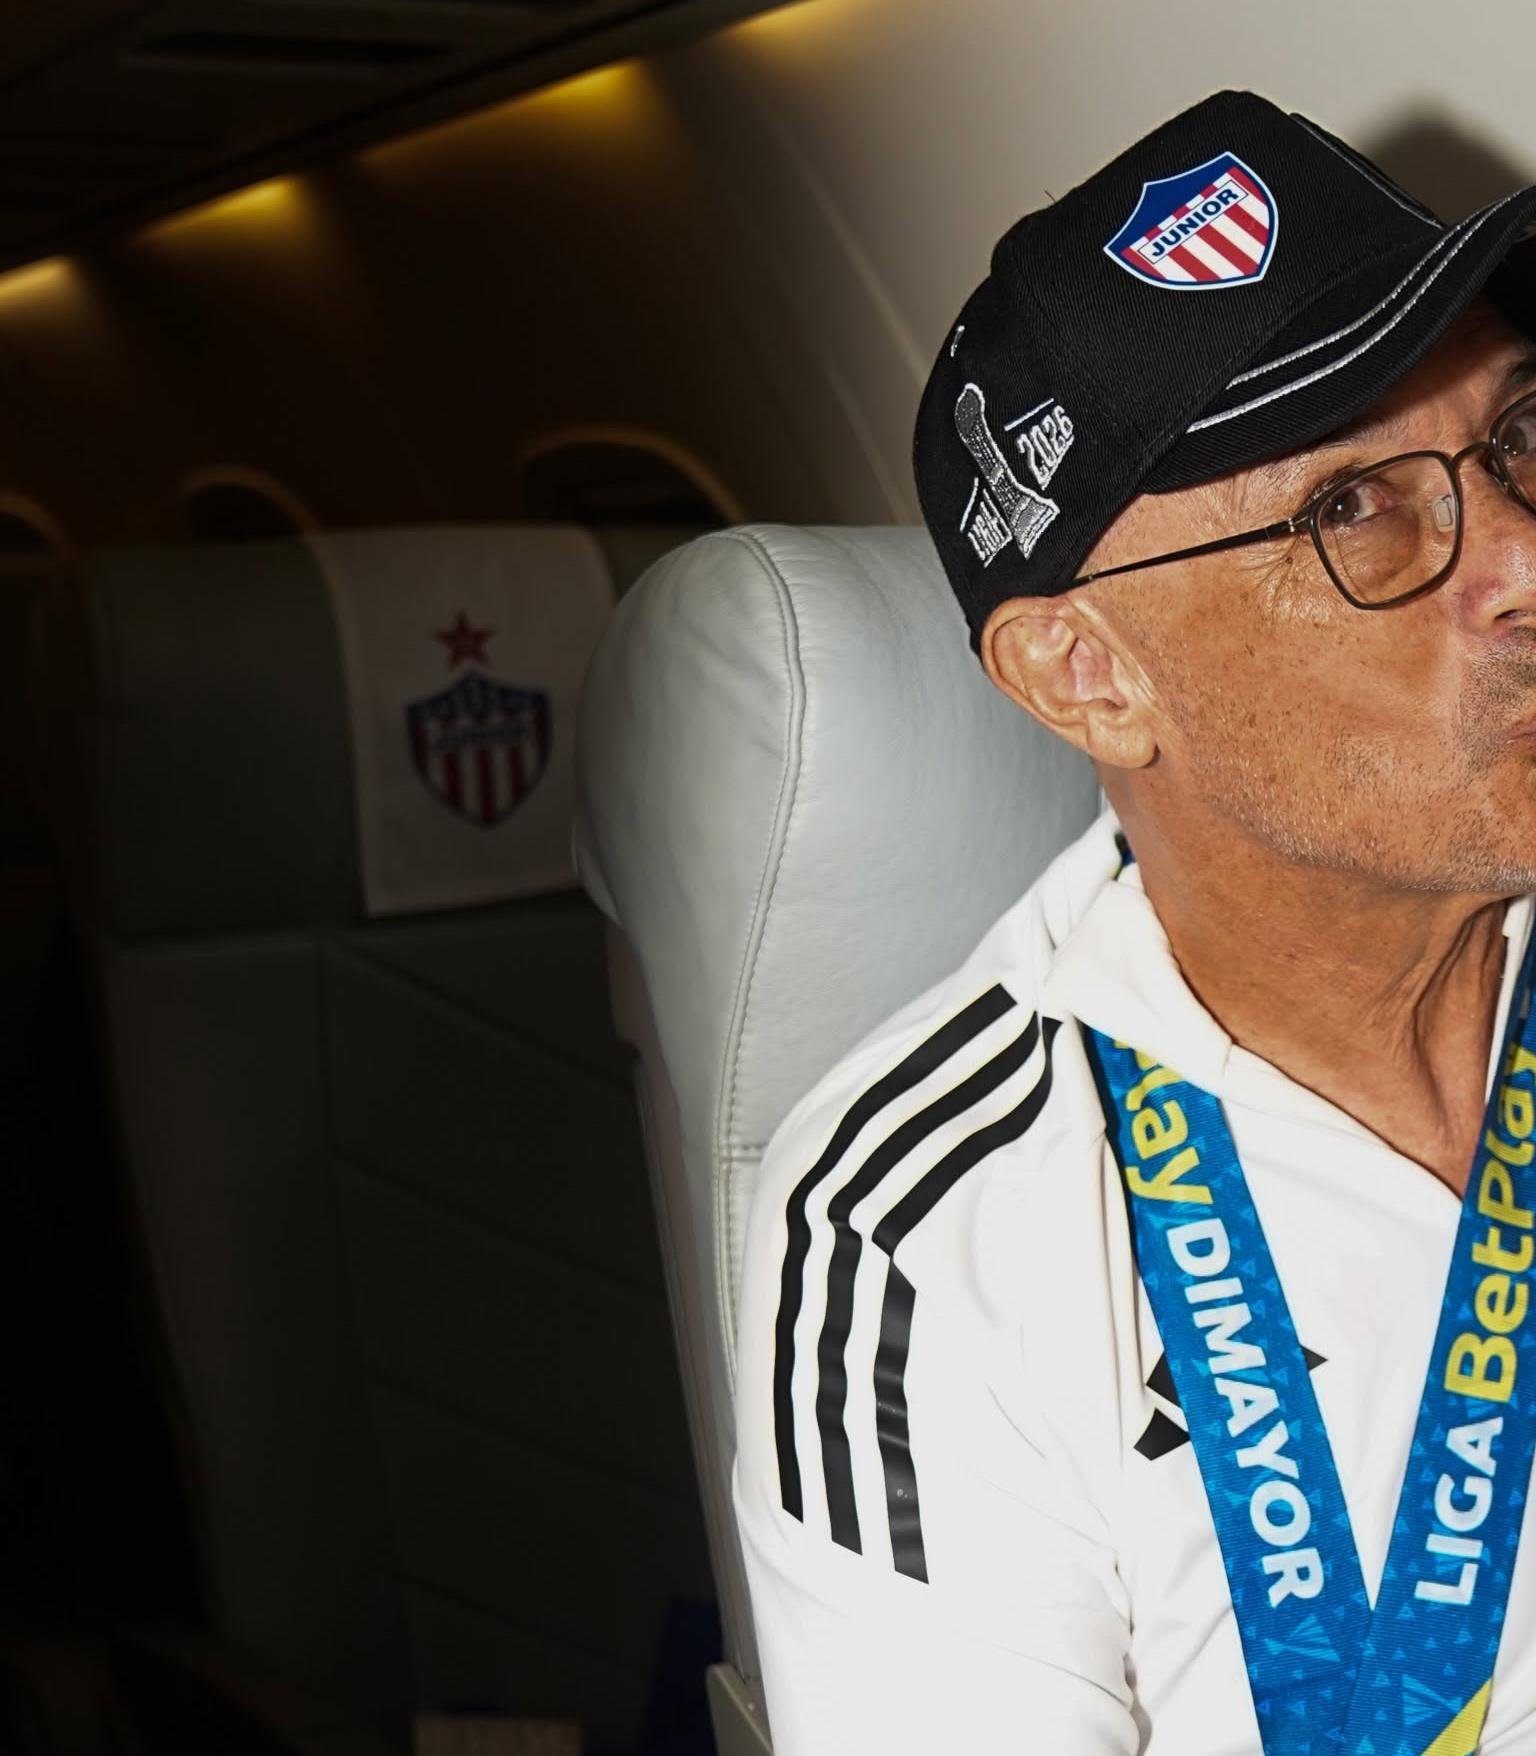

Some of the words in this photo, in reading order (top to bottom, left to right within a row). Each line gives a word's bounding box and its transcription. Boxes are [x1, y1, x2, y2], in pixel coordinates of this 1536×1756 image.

[1150, 188, 1239, 257] JUNIOR
[1016, 404, 1074, 487] 2026
[1165, 1218, 1325, 1608] DIMAYOR
[1414, 1417, 1505, 1606] LIGA
